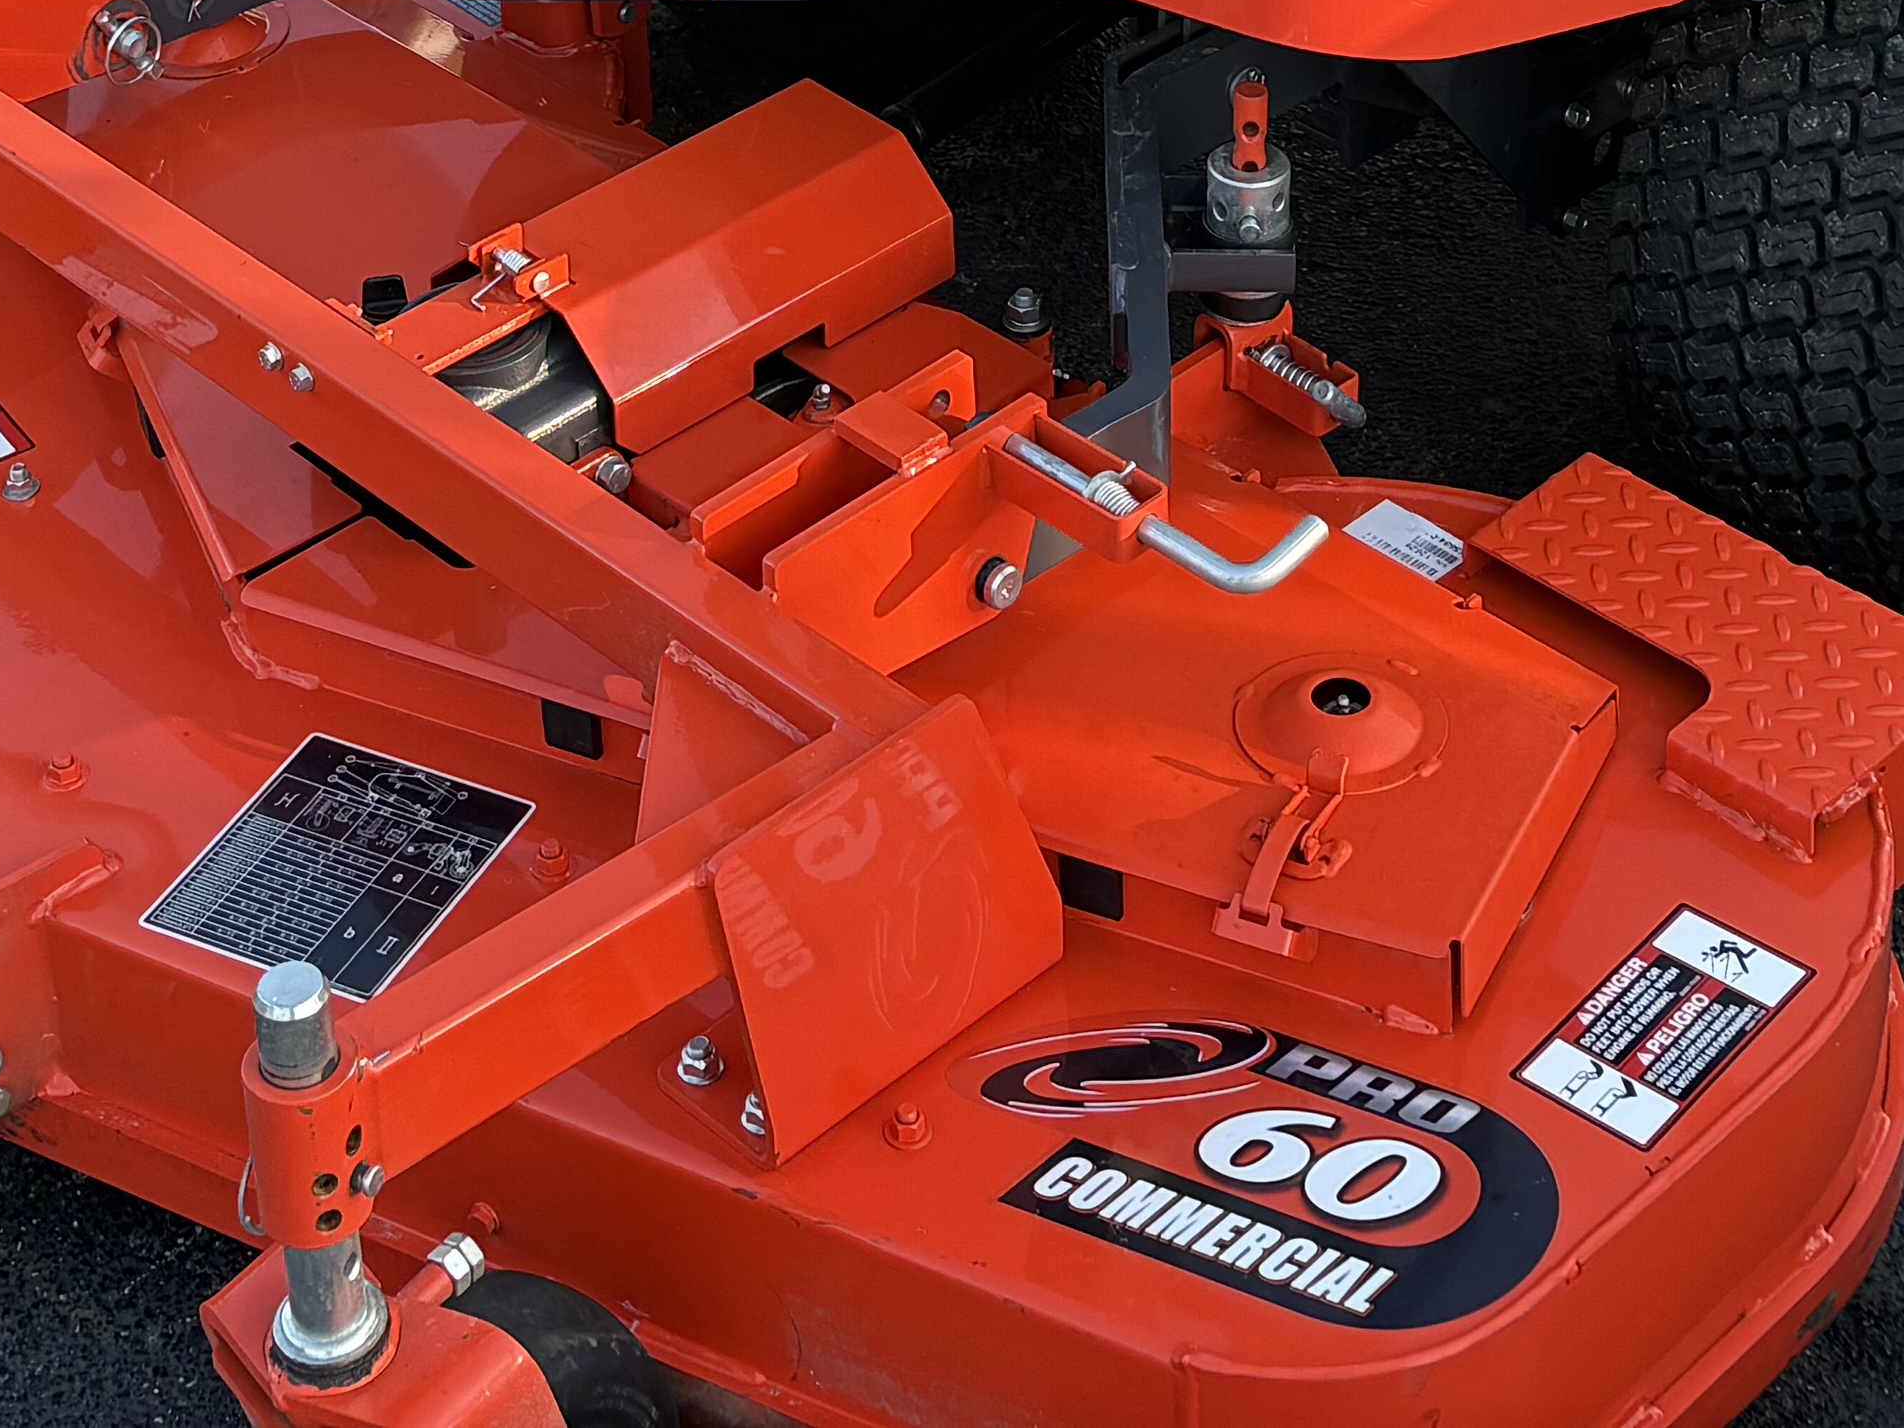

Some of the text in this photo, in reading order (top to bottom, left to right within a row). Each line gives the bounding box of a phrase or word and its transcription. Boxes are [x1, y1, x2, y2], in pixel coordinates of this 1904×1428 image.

[1578, 966, 1662, 1047] DO NOT PUT HANDS OR
[1584, 956, 1649, 1014] DANGER
[1589, 966, 1681, 1053] FEET INTO MOWER WHEN
[1643, 991, 1712, 1054] PELIGRO
[1602, 1030, 1636, 1060] ENGINE
[1264, 1042, 1484, 1135] PRO
[1194, 1107, 1444, 1224] 60
[1031, 1153, 1399, 1317] COMMERCIAL
